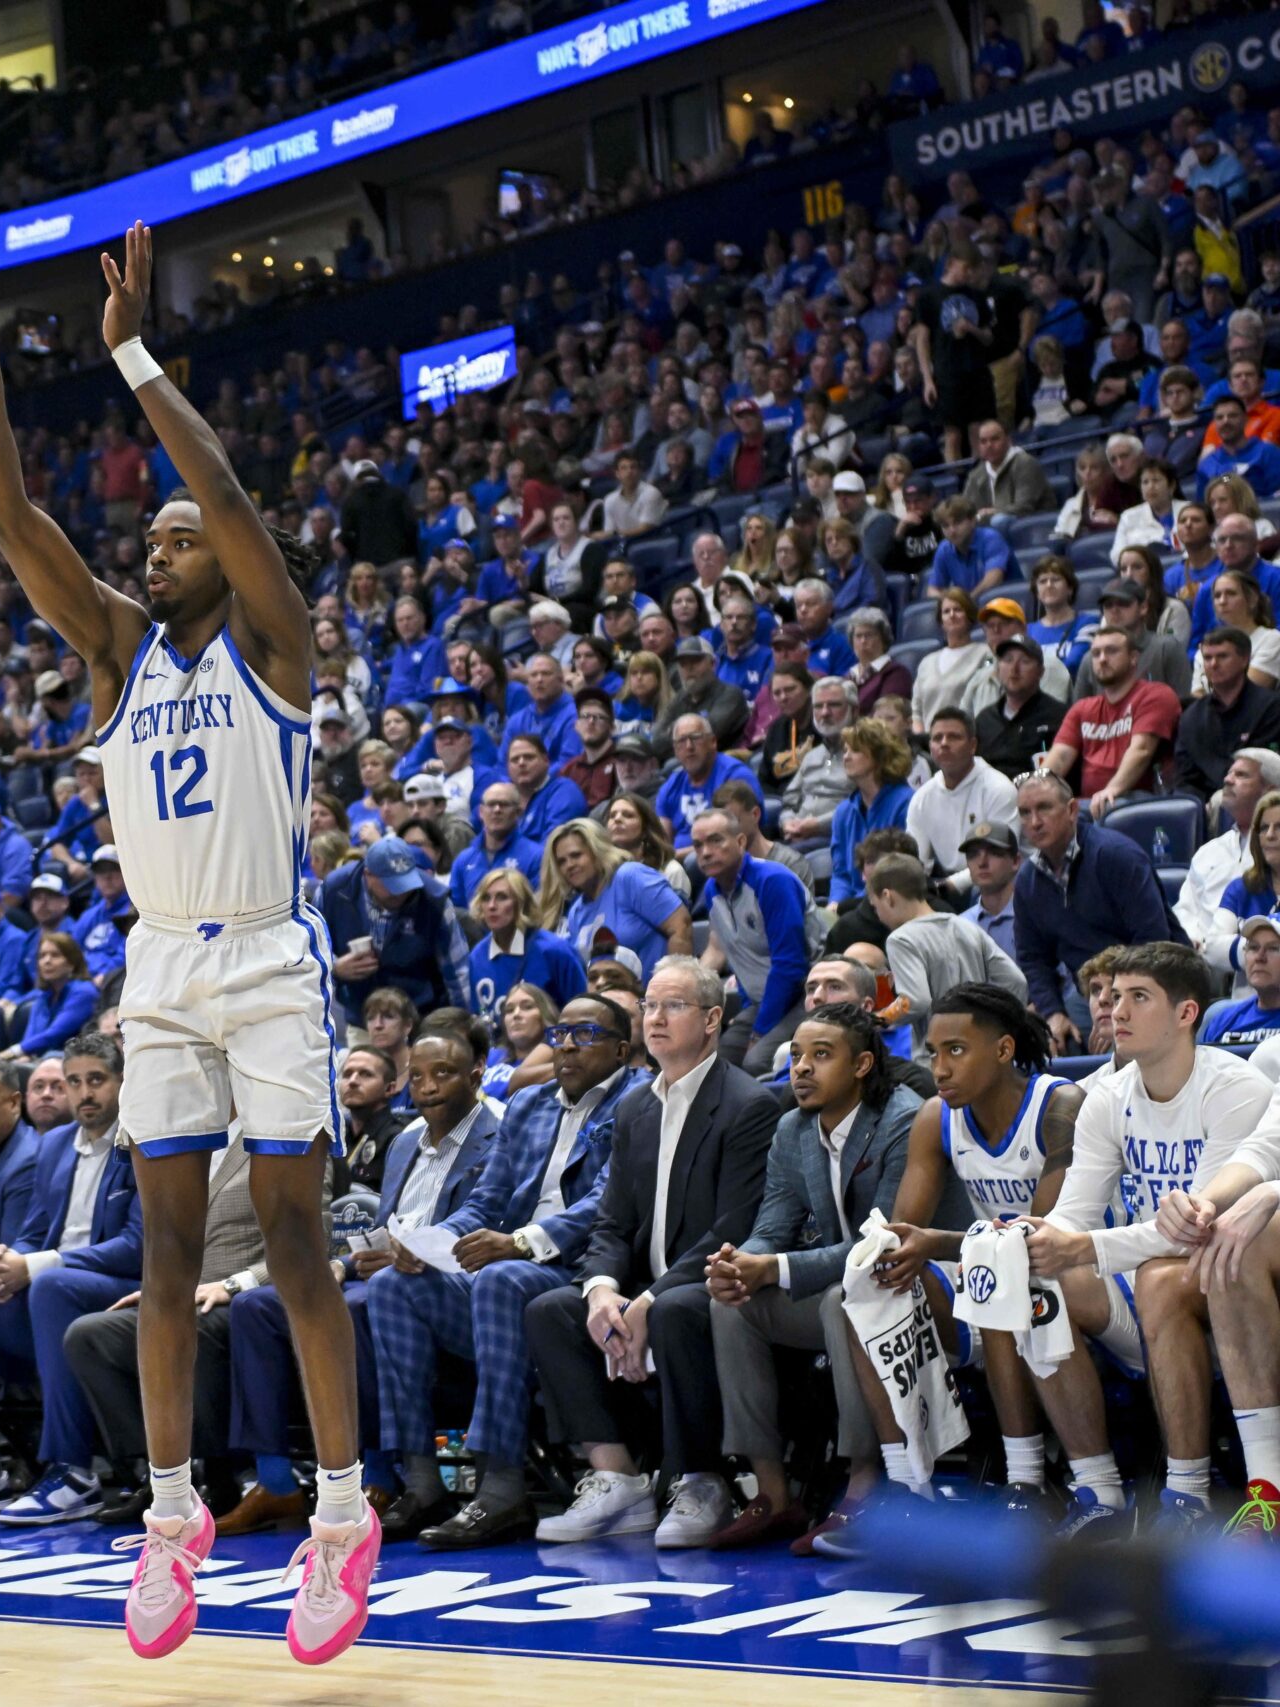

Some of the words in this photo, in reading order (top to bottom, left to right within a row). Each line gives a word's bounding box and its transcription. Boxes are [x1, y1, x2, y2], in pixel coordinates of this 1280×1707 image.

[917, 61, 1184, 164] SOUTHEASTERN
[805, 181, 843, 225] 116
[199, 657, 214, 673] SEC
[130, 694, 234, 744] KENTUCKY
[150, 744, 214, 820] 12
[968, 1265, 996, 1303] SEC
